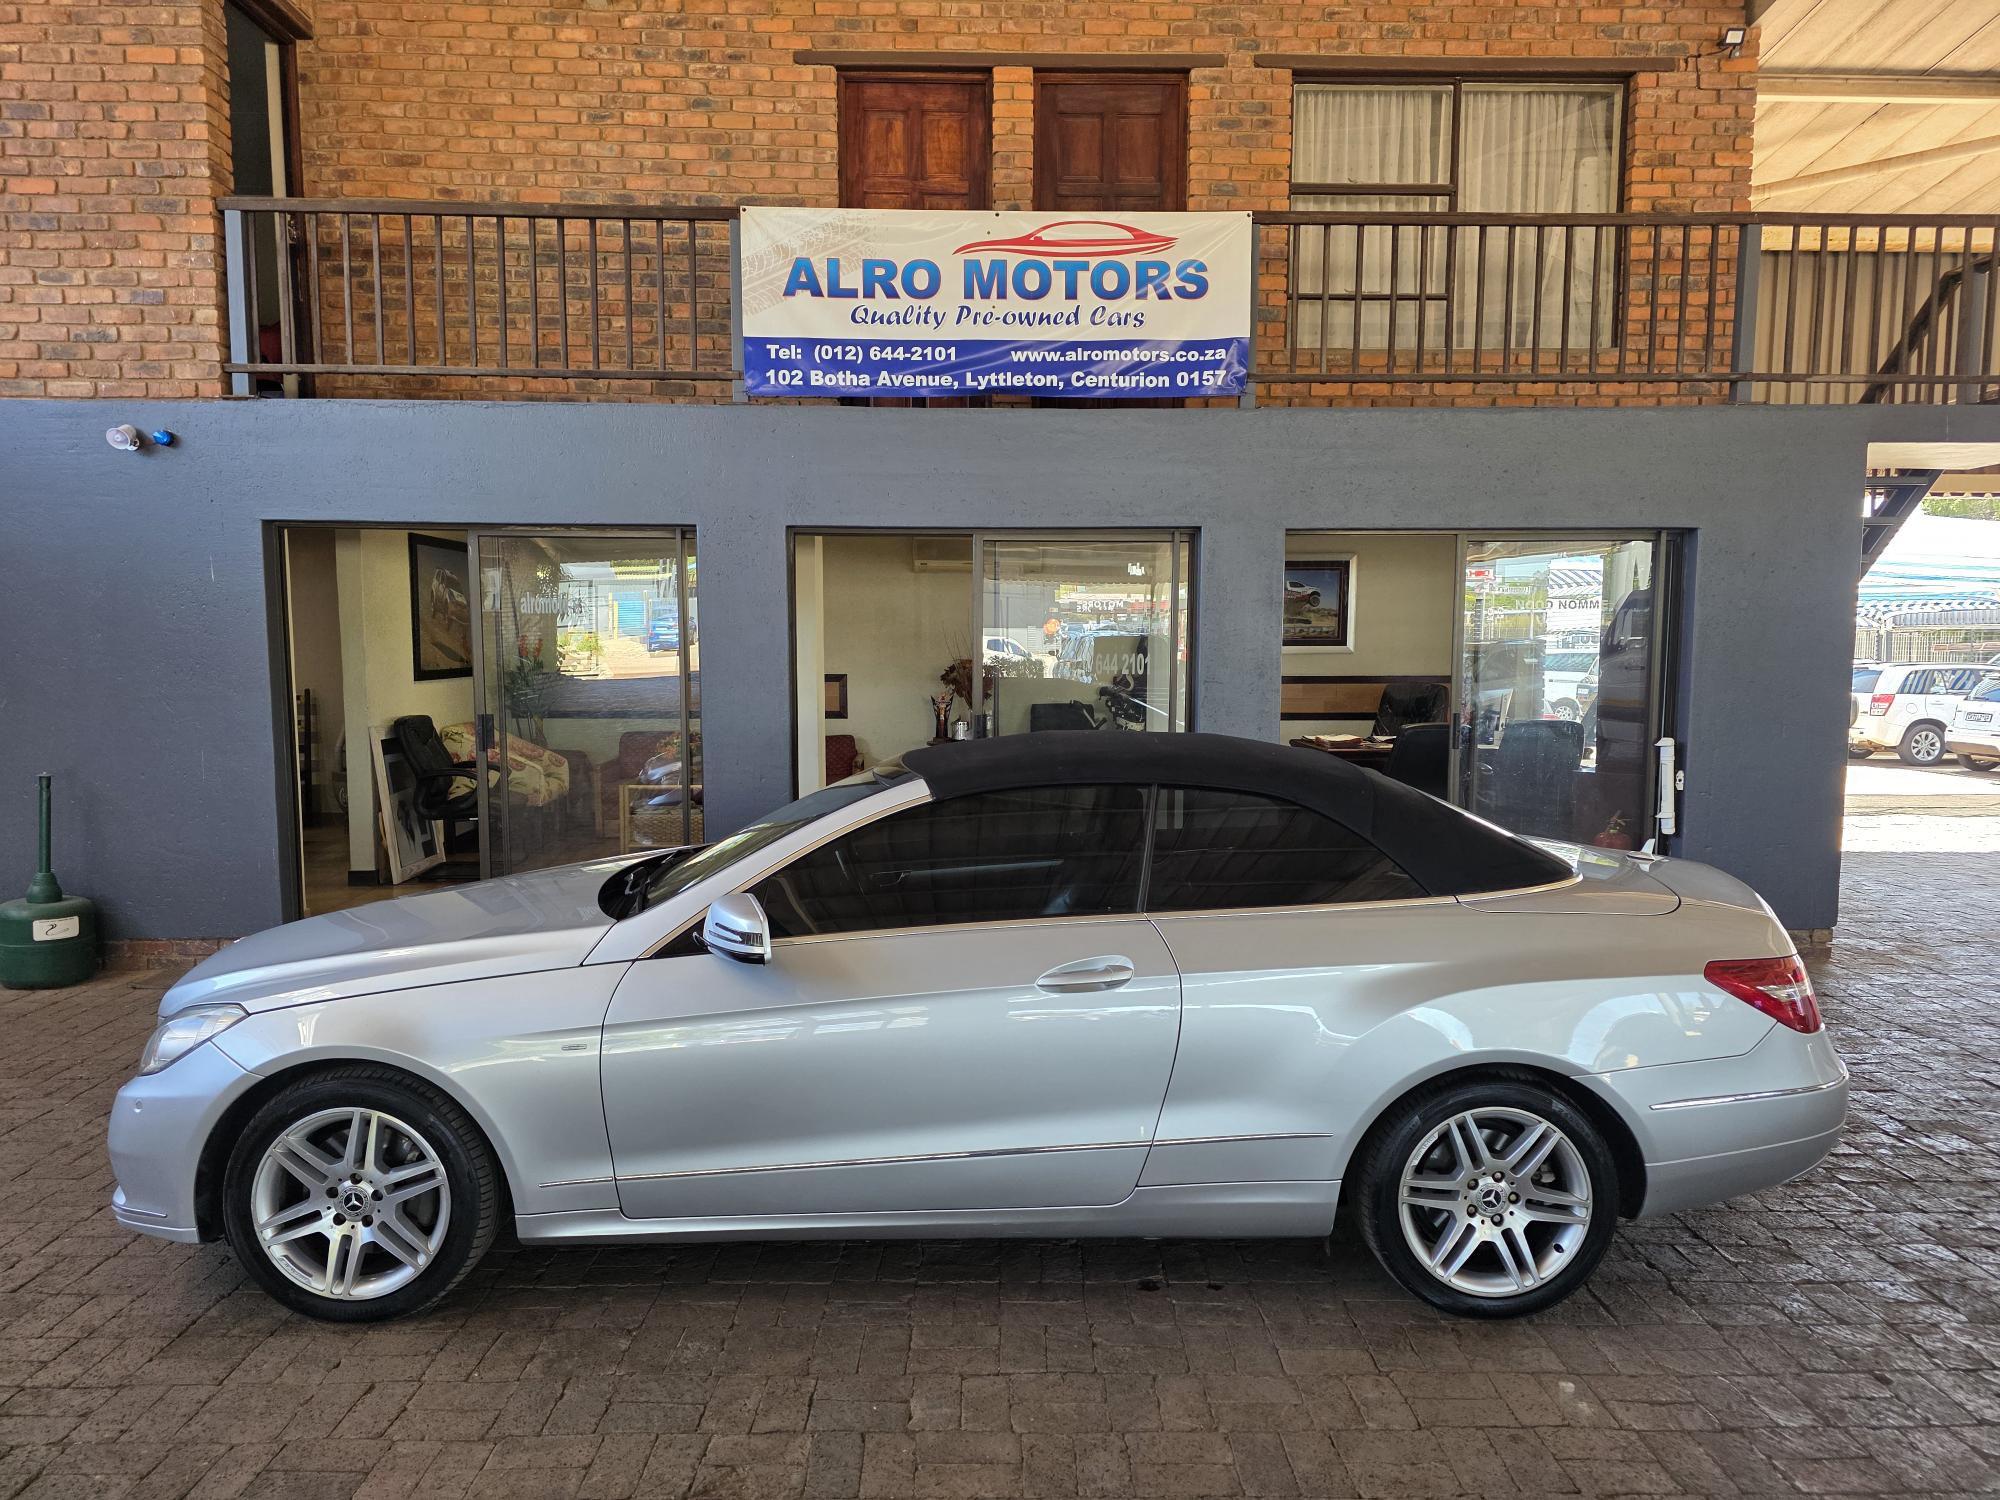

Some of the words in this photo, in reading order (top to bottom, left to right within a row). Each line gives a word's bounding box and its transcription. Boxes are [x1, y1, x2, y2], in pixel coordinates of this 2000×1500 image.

[782, 256, 942, 300] ALRO
[963, 258, 1209, 300] MOTORS
[850, 304, 947, 330] Quality
[955, 304, 1081, 327] Pre-owned
[1089, 305, 1145, 328] Cars
[766, 344, 802, 360] Tel:
[813, 345, 864, 364] (012)
[869, 346, 957, 361] 644-2101
[1011, 347, 1227, 362] www.alromotors.co.za
[766, 369, 804, 386] 102
[810, 370, 871, 387] Botha
[877, 371, 959, 390] Avenue,
[965, 371, 1065, 391] Lyttleton,
[1071, 371, 1170, 388] Centurion
[1176, 370, 1227, 386] 0157
